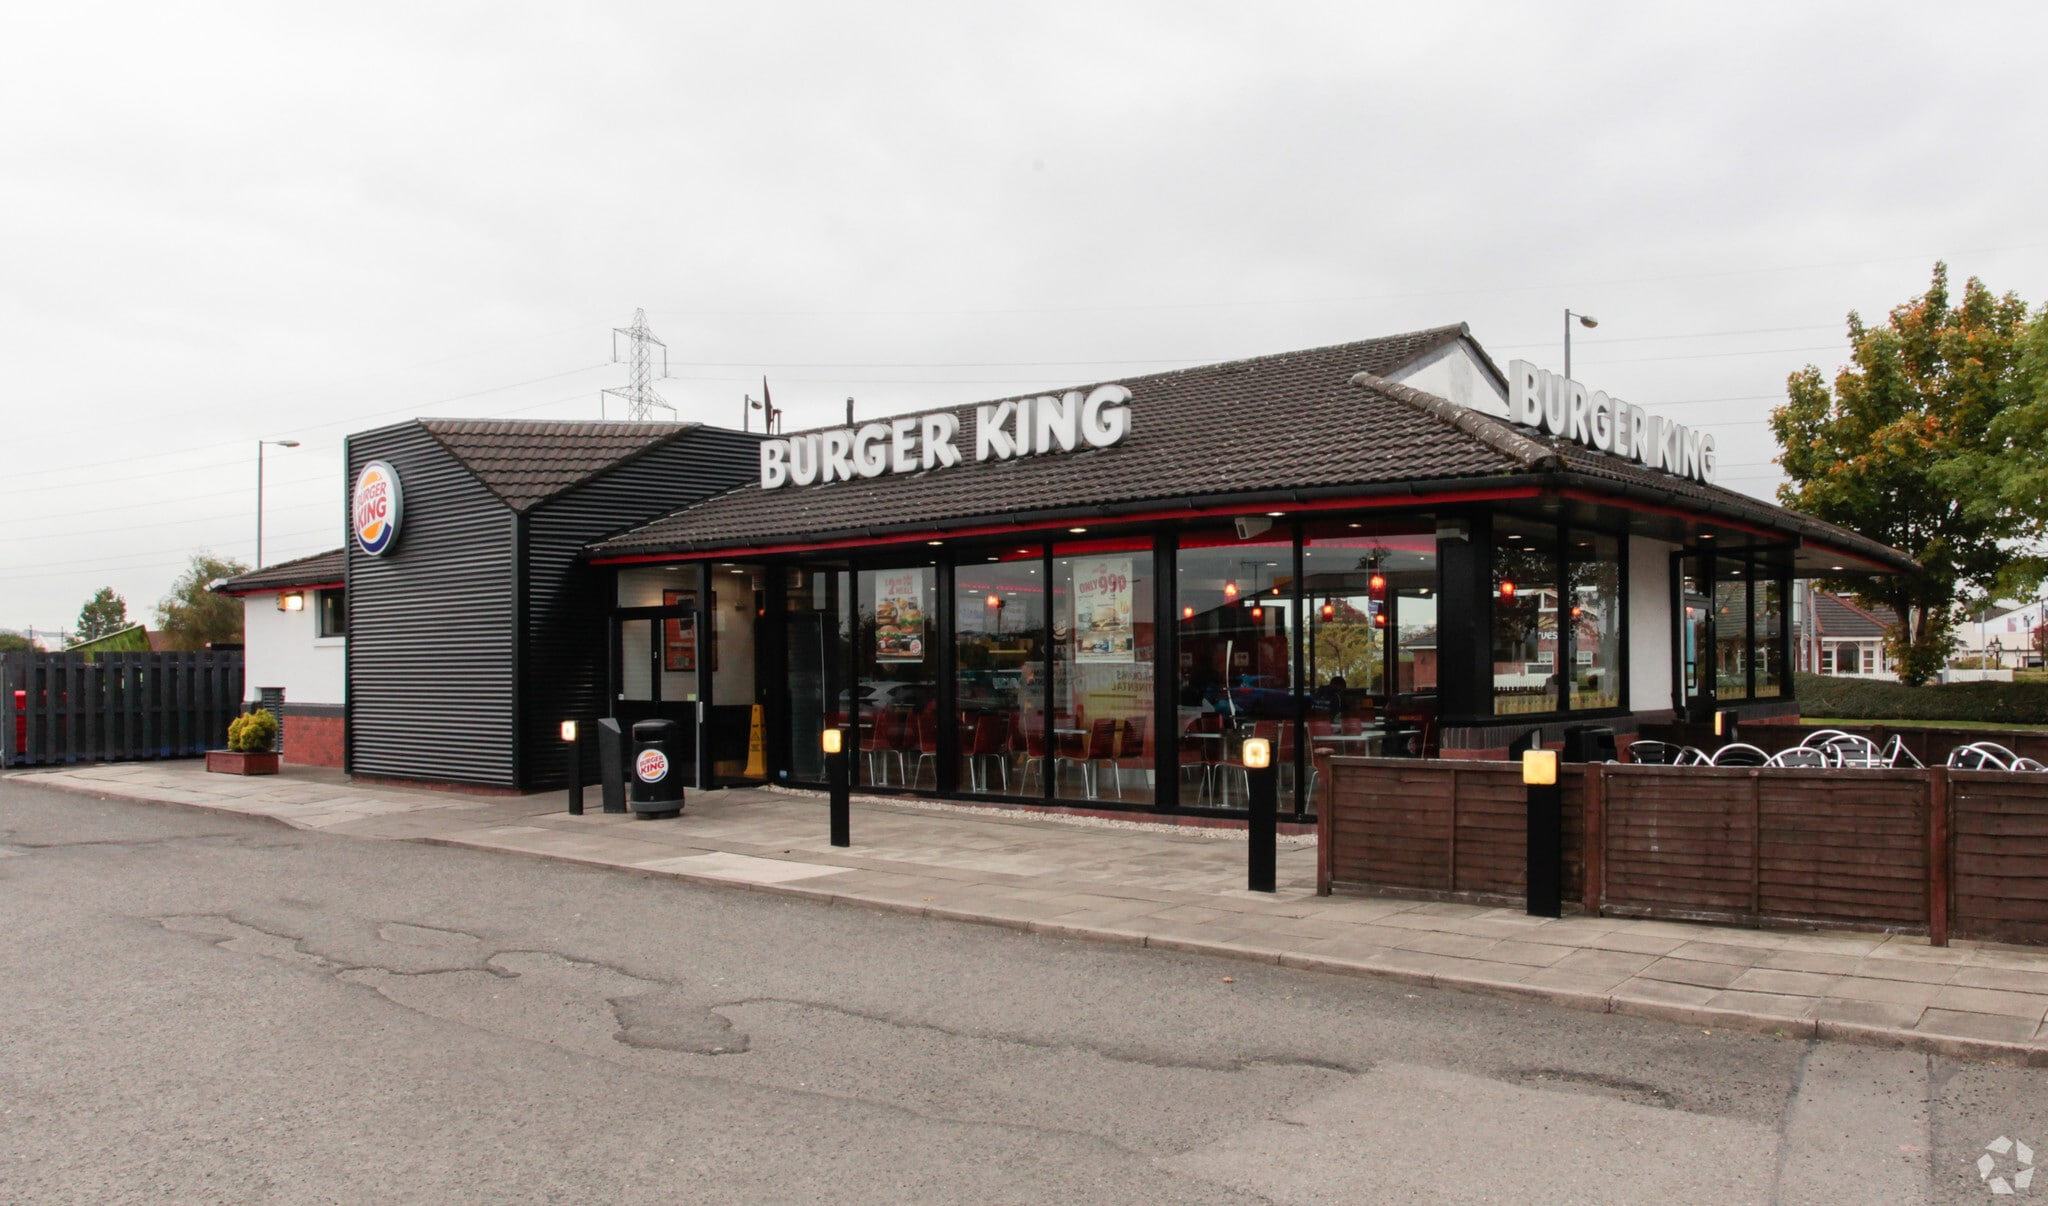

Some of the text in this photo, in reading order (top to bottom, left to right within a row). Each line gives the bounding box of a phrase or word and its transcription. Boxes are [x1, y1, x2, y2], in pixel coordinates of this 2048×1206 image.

[1509, 359, 1717, 485] BURGER KING
[760, 384, 1132, 489] BURGER KING
[357, 482, 387, 506] BURGER
[357, 497, 387, 531] KING
[1079, 573, 1127, 595] ONLY 99p
[639, 755, 664, 767] BURGER
[639, 761, 664, 776] KING
